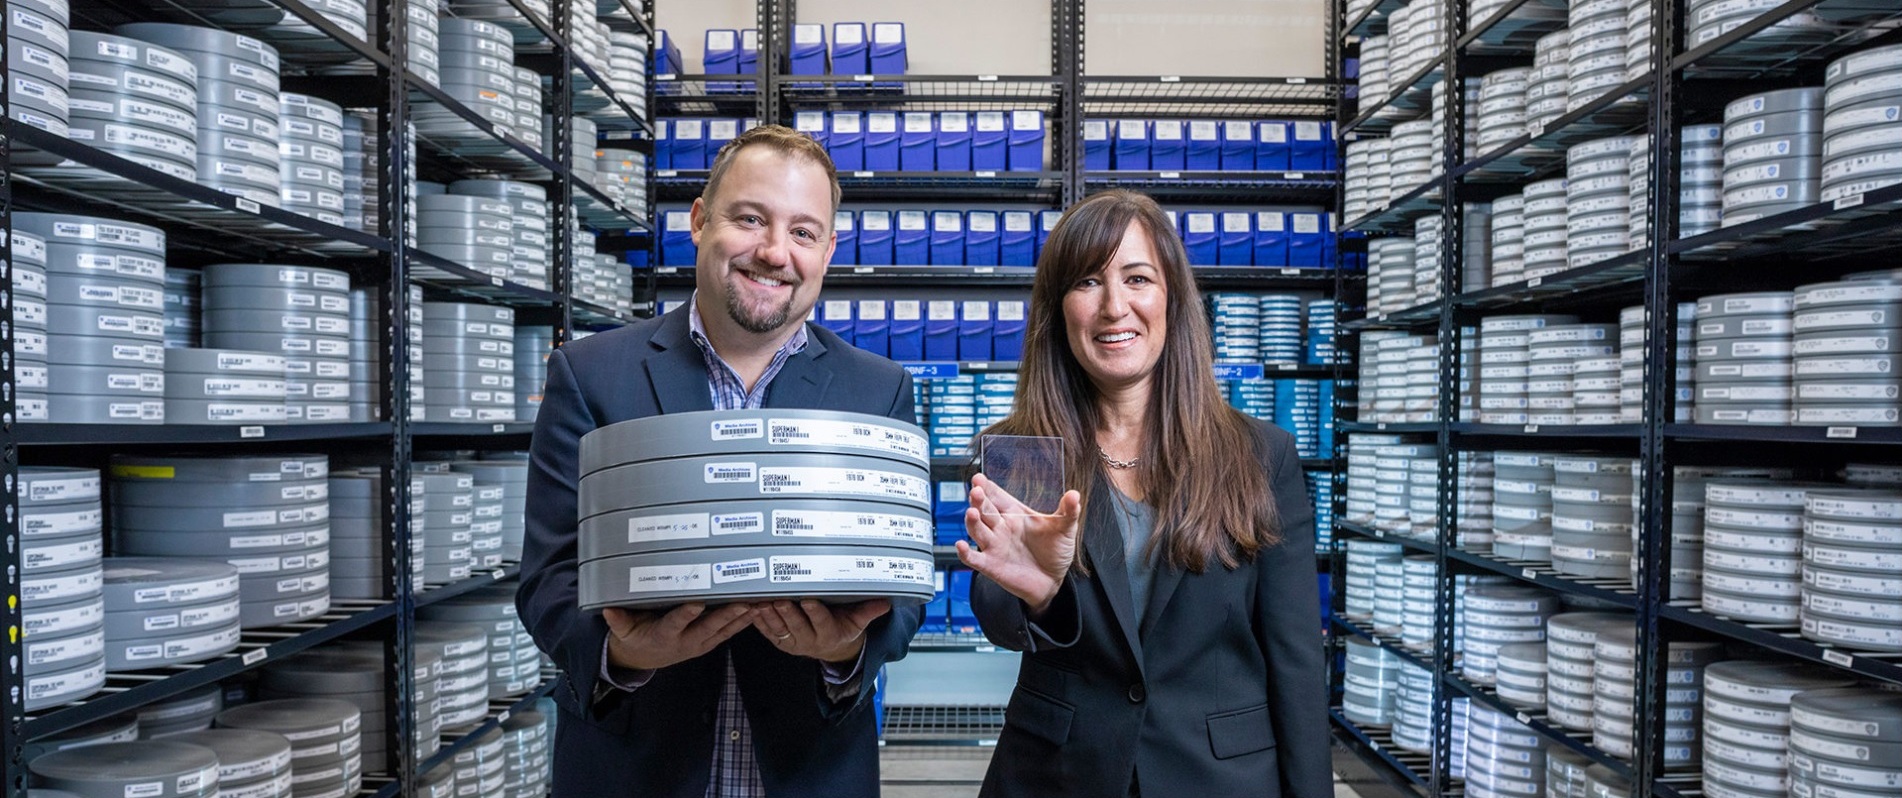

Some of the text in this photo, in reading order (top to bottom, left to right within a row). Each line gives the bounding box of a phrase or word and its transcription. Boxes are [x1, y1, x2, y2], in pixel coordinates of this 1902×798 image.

[772, 425, 796, 434] SUPERMAN
[762, 474, 787, 482] SUPERMAN
[775, 517, 800, 525] SUPERMAN
[773, 563, 798, 571] SUPERMAN
